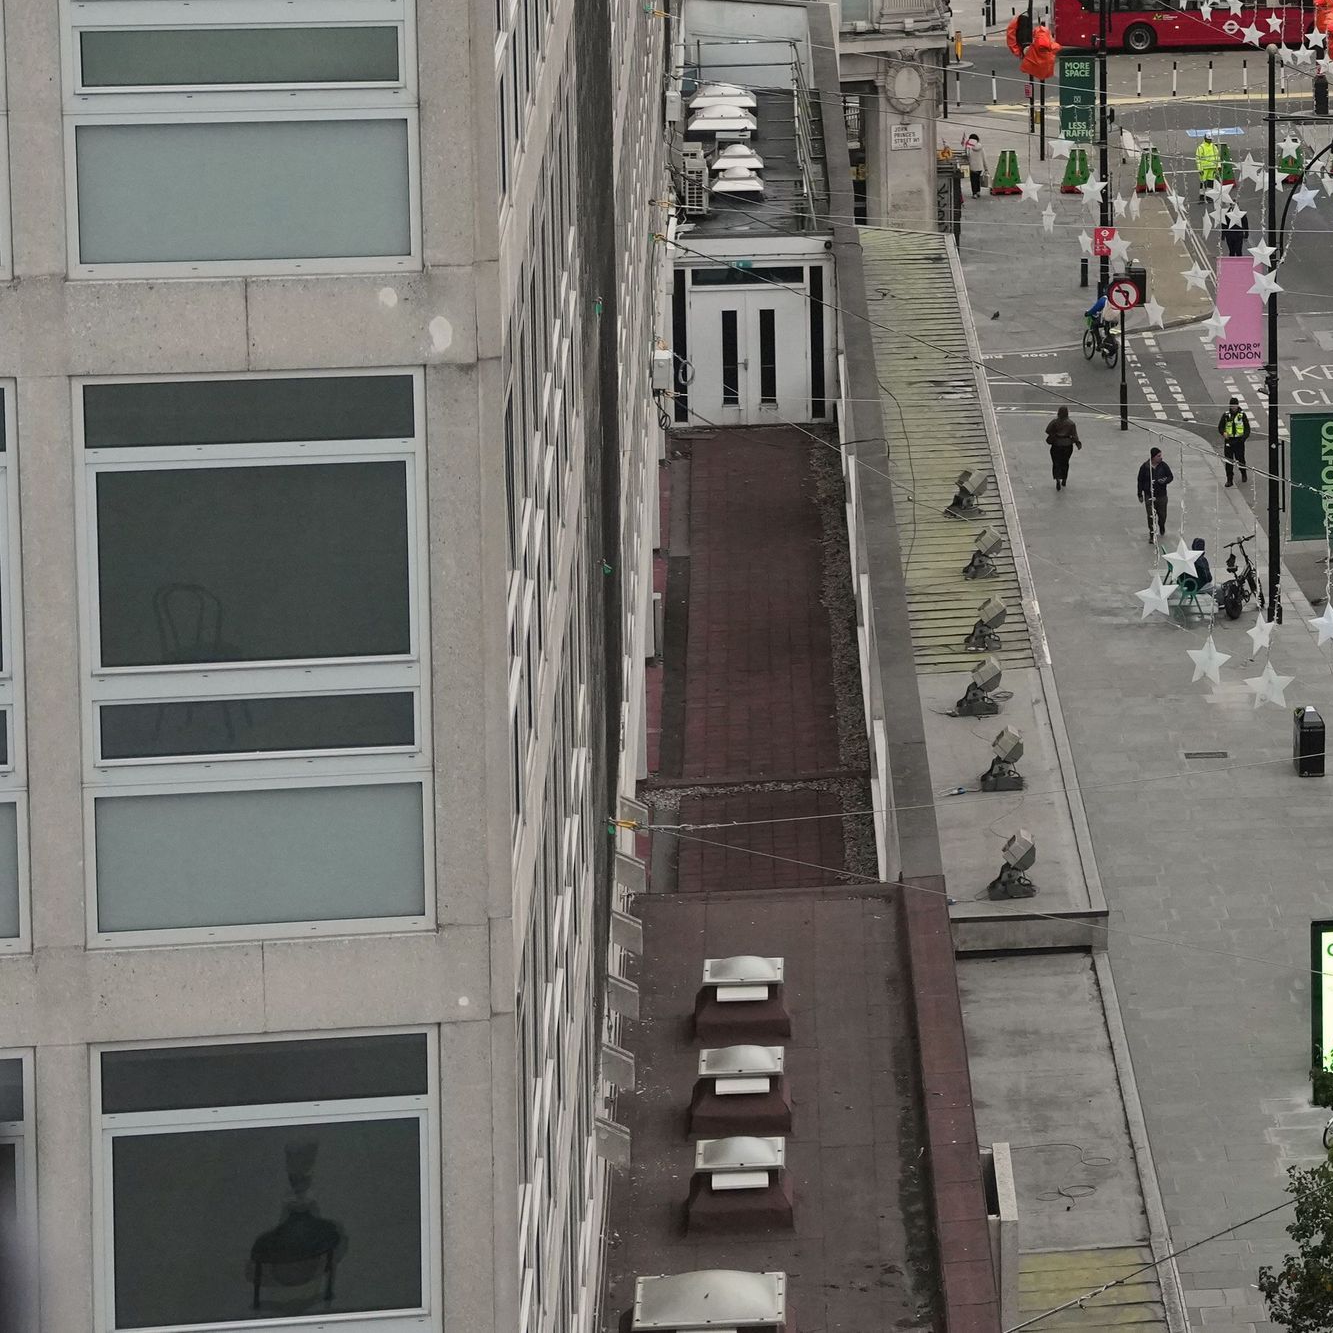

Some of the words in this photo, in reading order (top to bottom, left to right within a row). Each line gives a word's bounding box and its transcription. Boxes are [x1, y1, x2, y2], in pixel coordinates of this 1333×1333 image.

[1064, 62, 1090, 70] MORE
[1065, 70, 1090, 78] SPACE
[1068, 122, 1087, 130] LESS
[1062, 130, 1094, 138] TRAFFIC
[1218, 343, 1252, 352] MAYOR
[1218, 351, 1262, 361] LONDON
